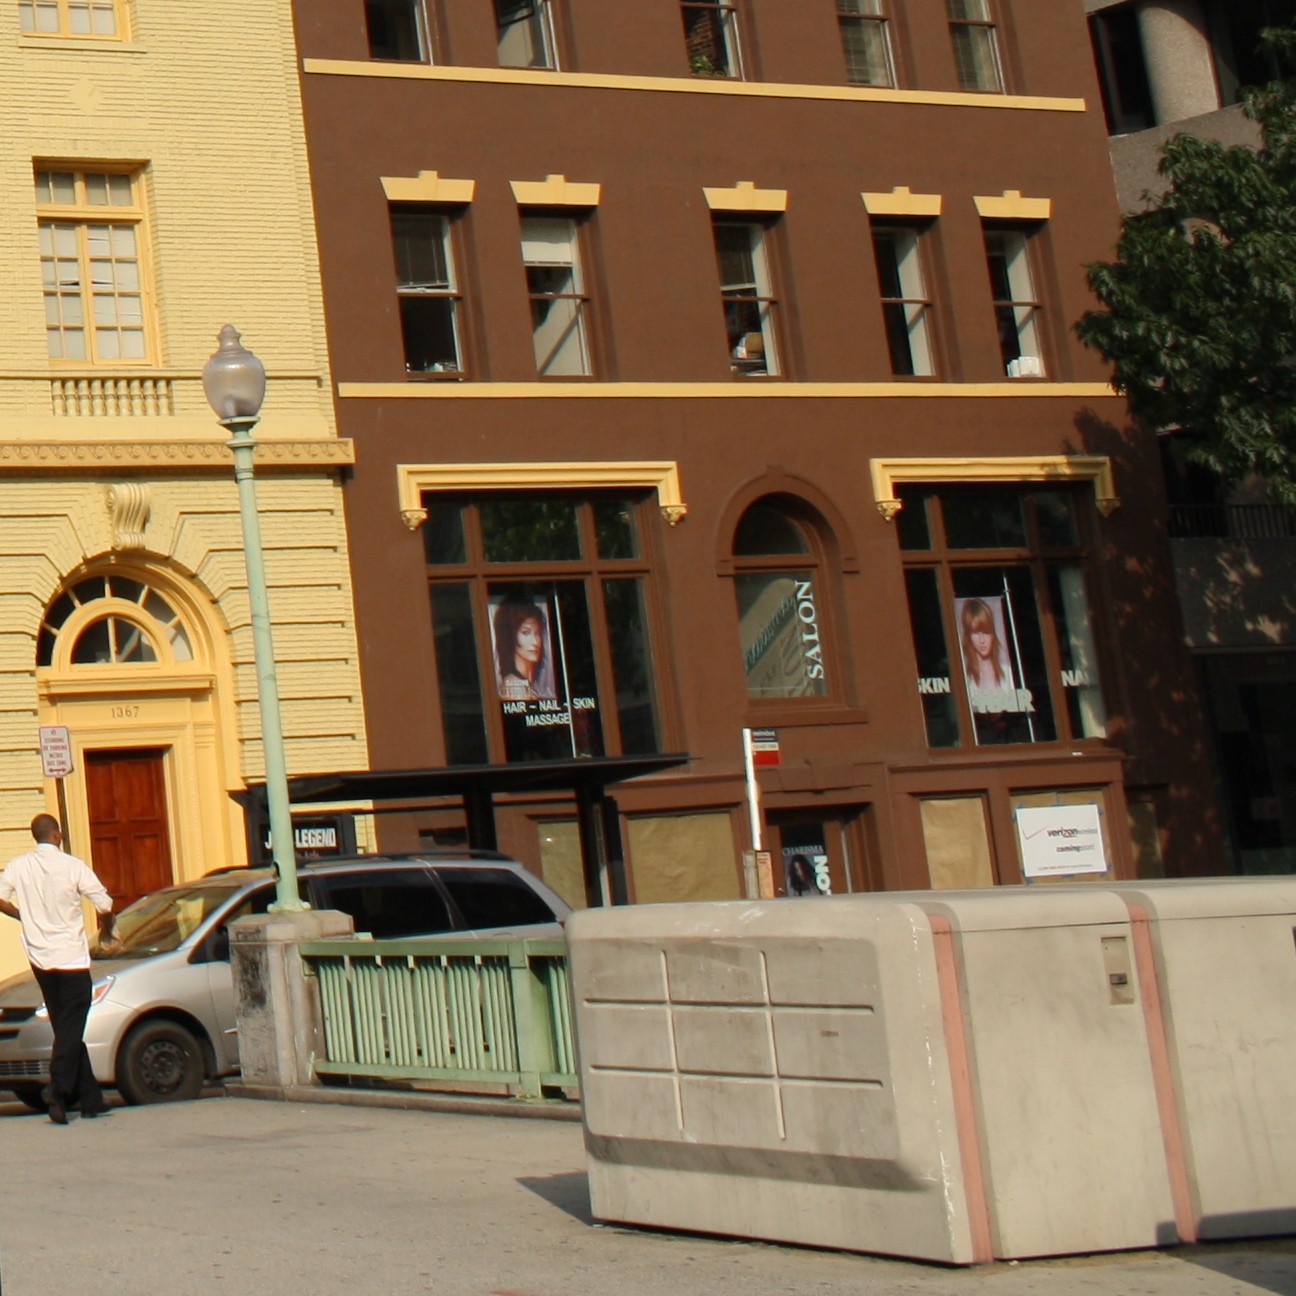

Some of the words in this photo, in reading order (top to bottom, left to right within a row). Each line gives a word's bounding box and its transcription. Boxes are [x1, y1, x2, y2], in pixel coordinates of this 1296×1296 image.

[795, 580, 825, 679] SALON
[111, 706, 140, 718] 1367
[503, 702, 527, 714] HAIR
[538, 700, 561, 711] NAIL
[573, 697, 595, 709] SKIN
[525, 713, 571, 727] MASSAGE
[295, 828, 337, 848] LEGEND
[782, 845, 824, 856] CHARISMA
[813, 855, 832, 896] ON
